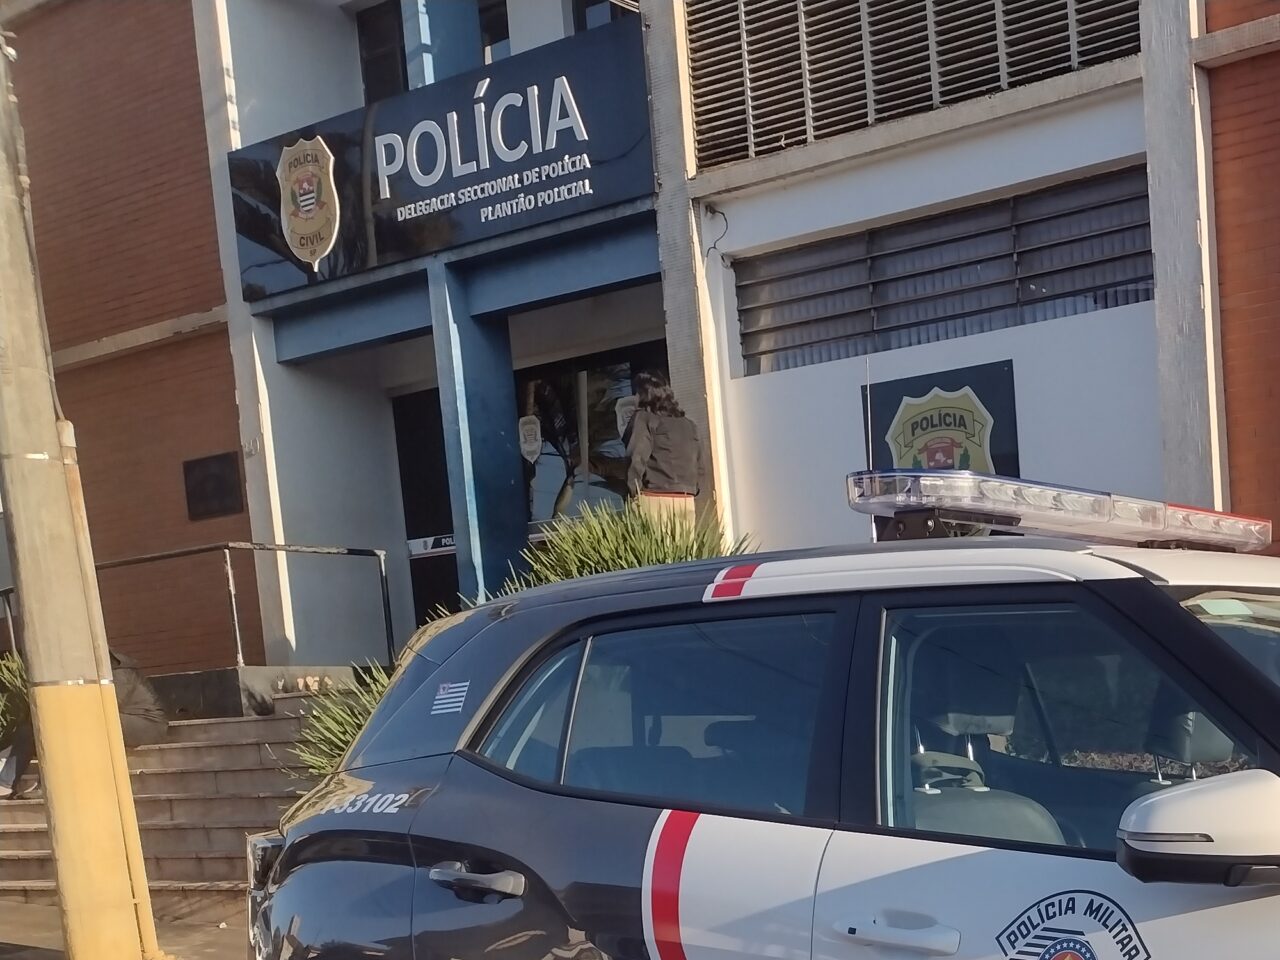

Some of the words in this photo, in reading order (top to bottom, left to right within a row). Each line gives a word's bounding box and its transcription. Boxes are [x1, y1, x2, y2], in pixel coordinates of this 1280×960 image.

[375, 75, 589, 200] POLÍCIA
[397, 192, 457, 222] DELEGACIA
[457, 173, 522, 205] SECCIONAL
[522, 167, 540, 186] DE
[541, 153, 591, 181] POLÍCIA
[480, 194, 535, 222] PLANTÃO
[537, 179, 594, 207] POLICIAL
[299, 231, 325, 247] CIVIL
[911, 410, 967, 437] POLÍCIA
[1005, 896, 1076, 950] POLÍCIA
